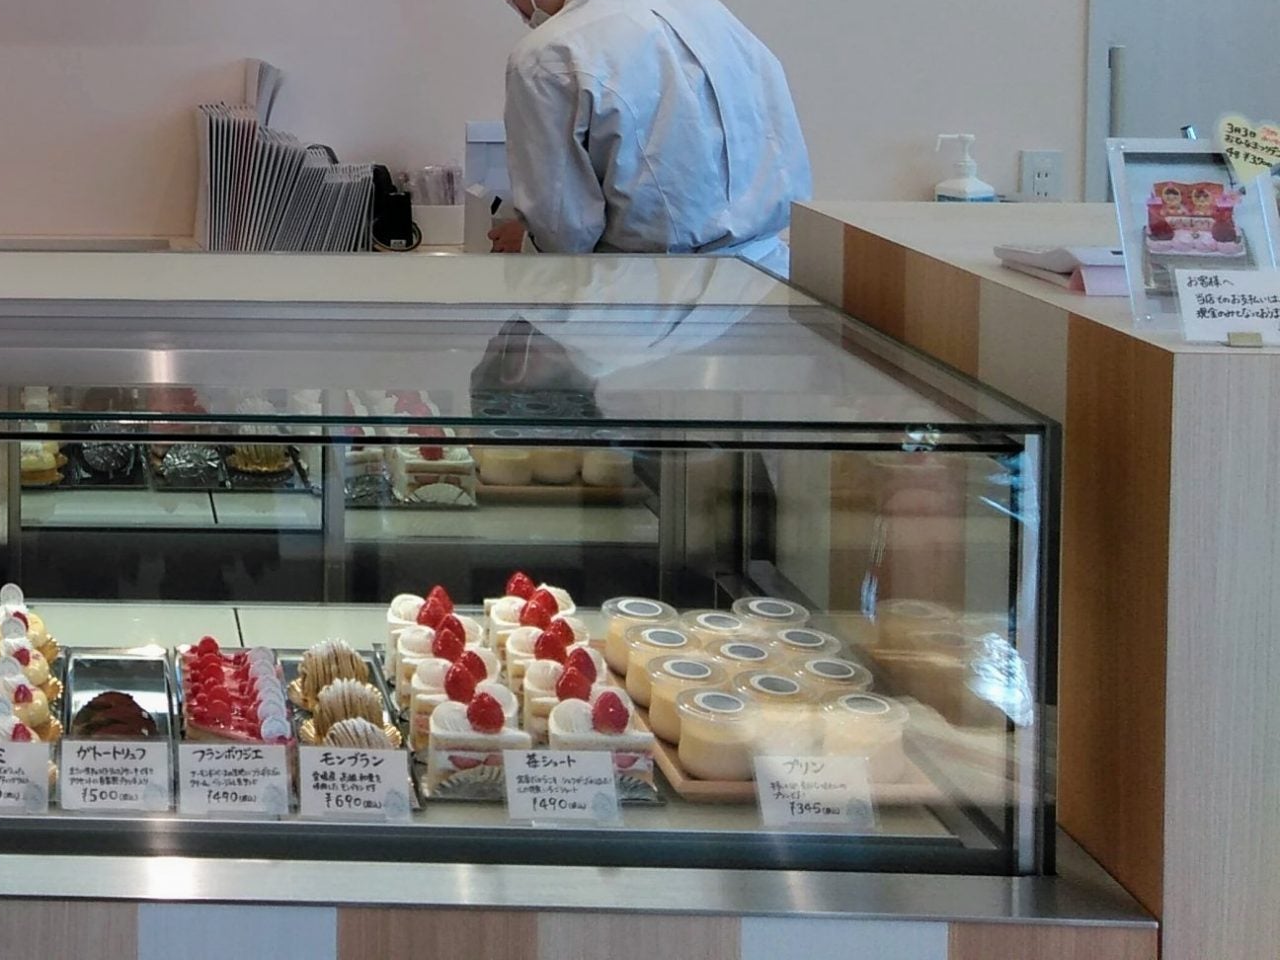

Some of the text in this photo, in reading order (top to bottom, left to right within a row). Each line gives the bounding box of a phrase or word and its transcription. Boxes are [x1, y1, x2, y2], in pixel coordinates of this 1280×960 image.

[1186, 275, 1235, 288] お客様へ
[77, 745, 146, 761] ガトートリュフ
[319, 752, 384, 768] モンブラン
[525, 753, 576, 768] 苺ショート
[782, 759, 825, 775] プリン
